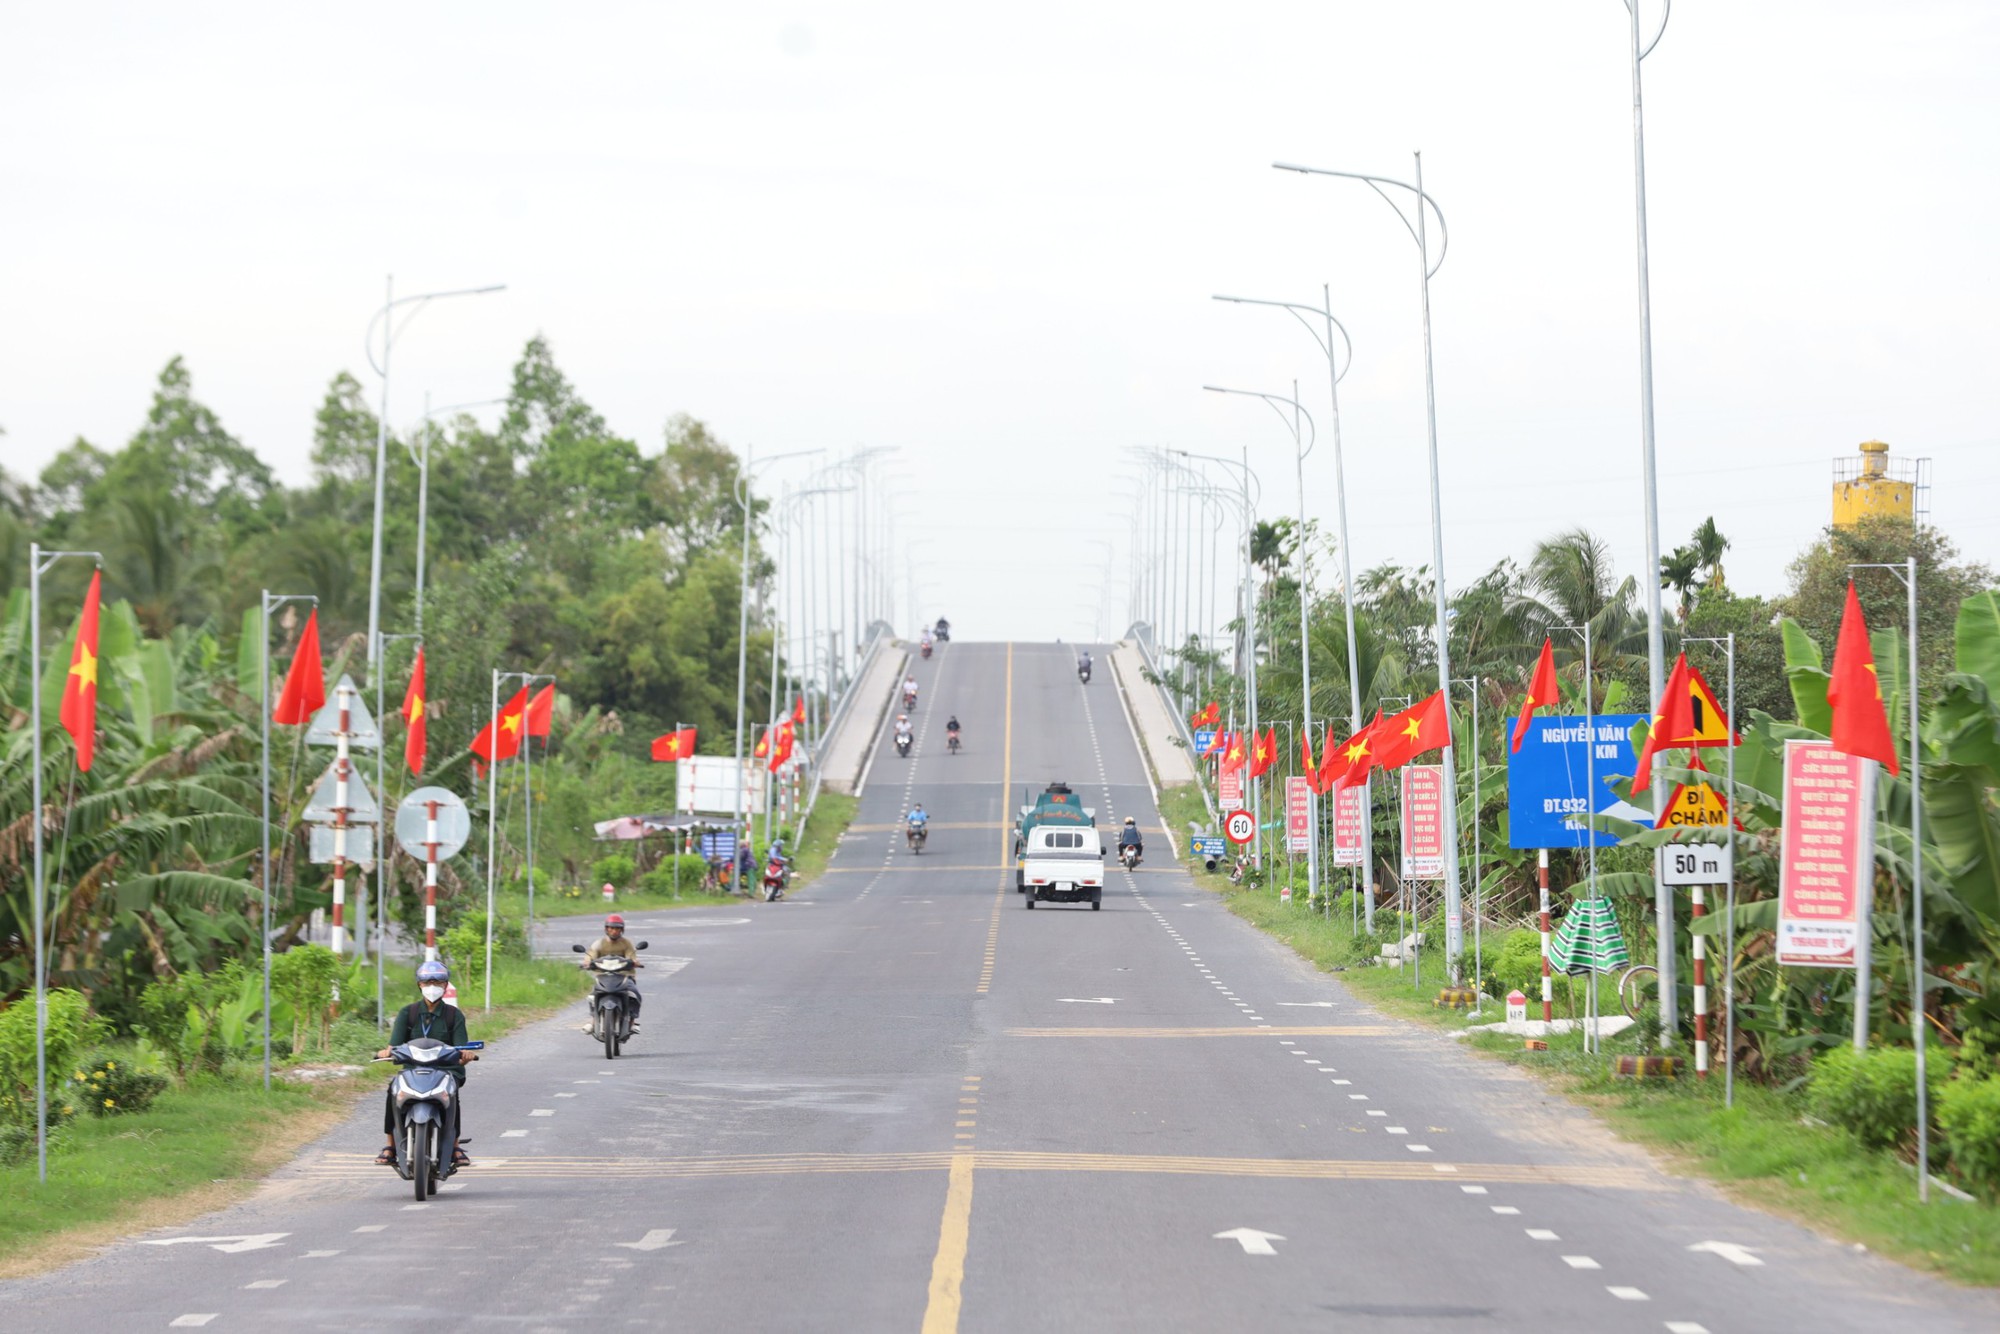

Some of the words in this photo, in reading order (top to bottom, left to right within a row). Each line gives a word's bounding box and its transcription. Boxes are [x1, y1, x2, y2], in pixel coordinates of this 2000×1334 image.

[1598, 724, 1624, 741] VĂN
[1595, 744, 1618, 759] KM
[1544, 797, 1587, 813] ĐT.932
[1687, 791, 1704, 805] ĐI
[1233, 820, 1248, 833] 60
[1675, 854, 1696, 874] 50
[1703, 860, 1718, 873] m
